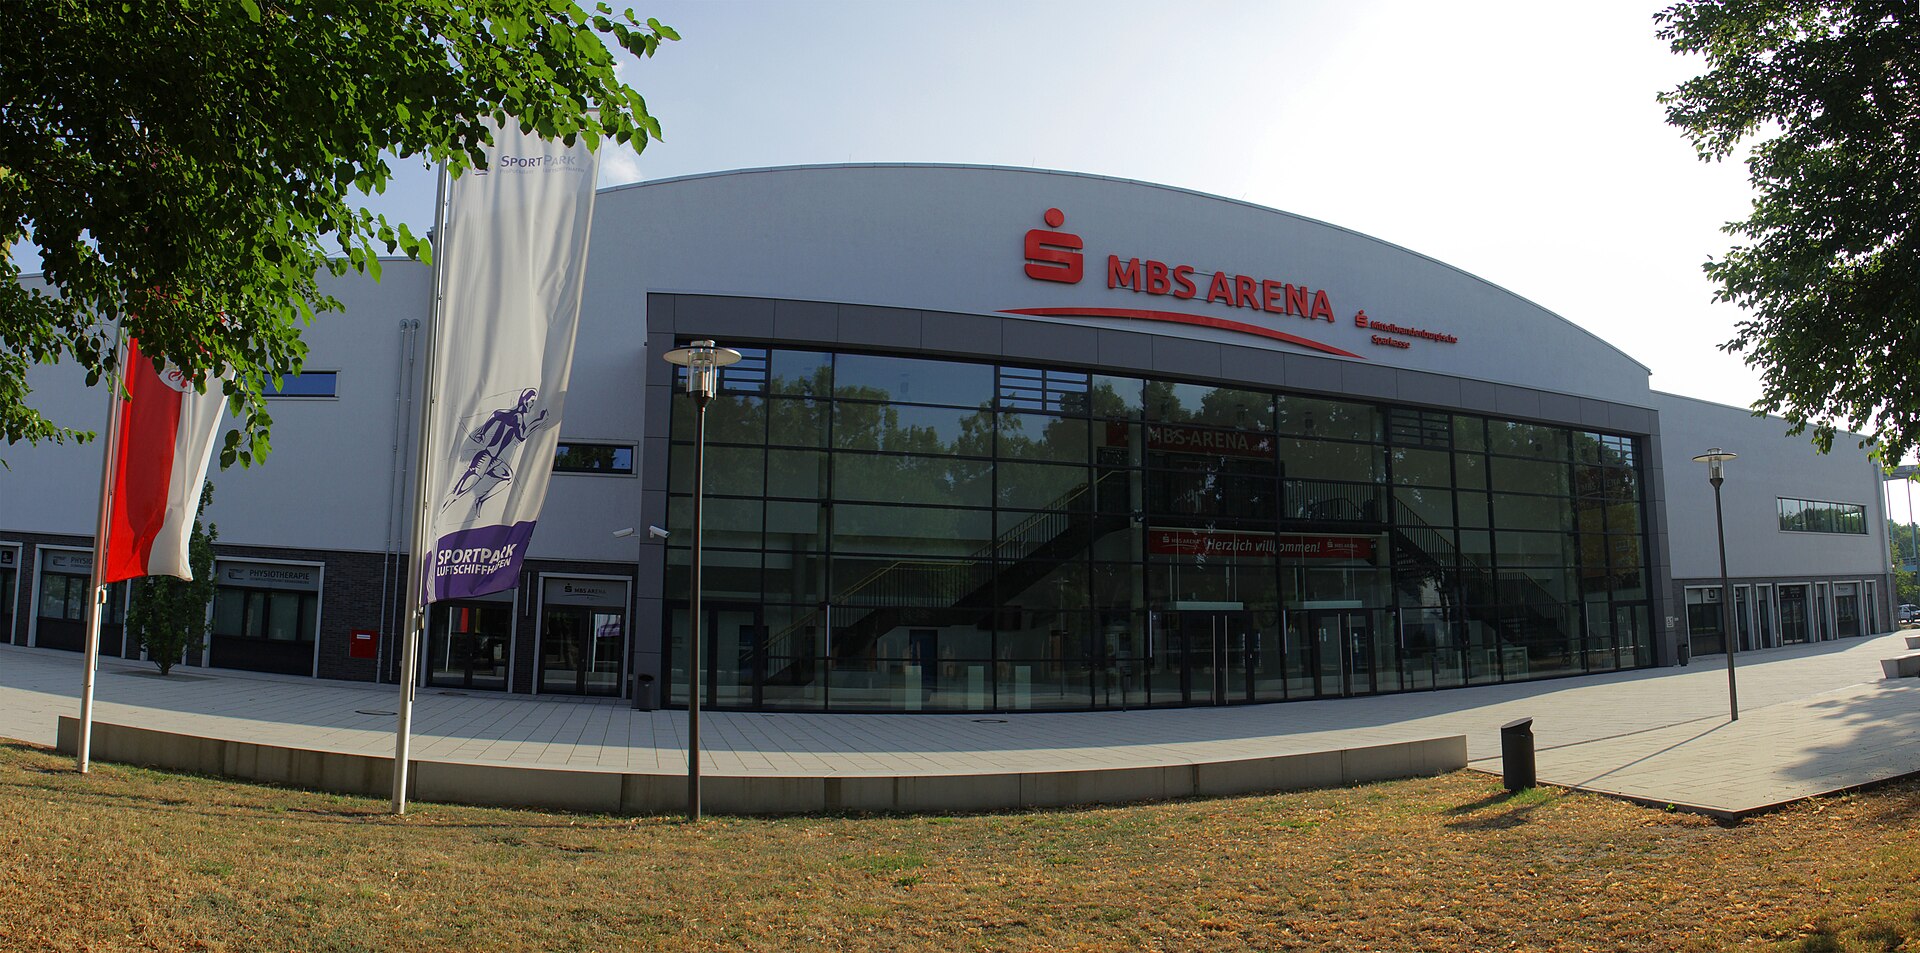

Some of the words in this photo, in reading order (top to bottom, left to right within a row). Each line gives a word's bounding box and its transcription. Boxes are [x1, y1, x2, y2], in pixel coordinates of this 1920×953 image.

[1107, 254, 1197, 299] MBS
[1207, 271, 1336, 323] ARENA
[1370, 320, 1458, 344] Mittelbrandenburgische
[1371, 334, 1411, 349] Sparkasse
[1207, 538, 1252, 551] Herzlich
[249, 569, 310, 580] PHYSIOTHERAPIE
